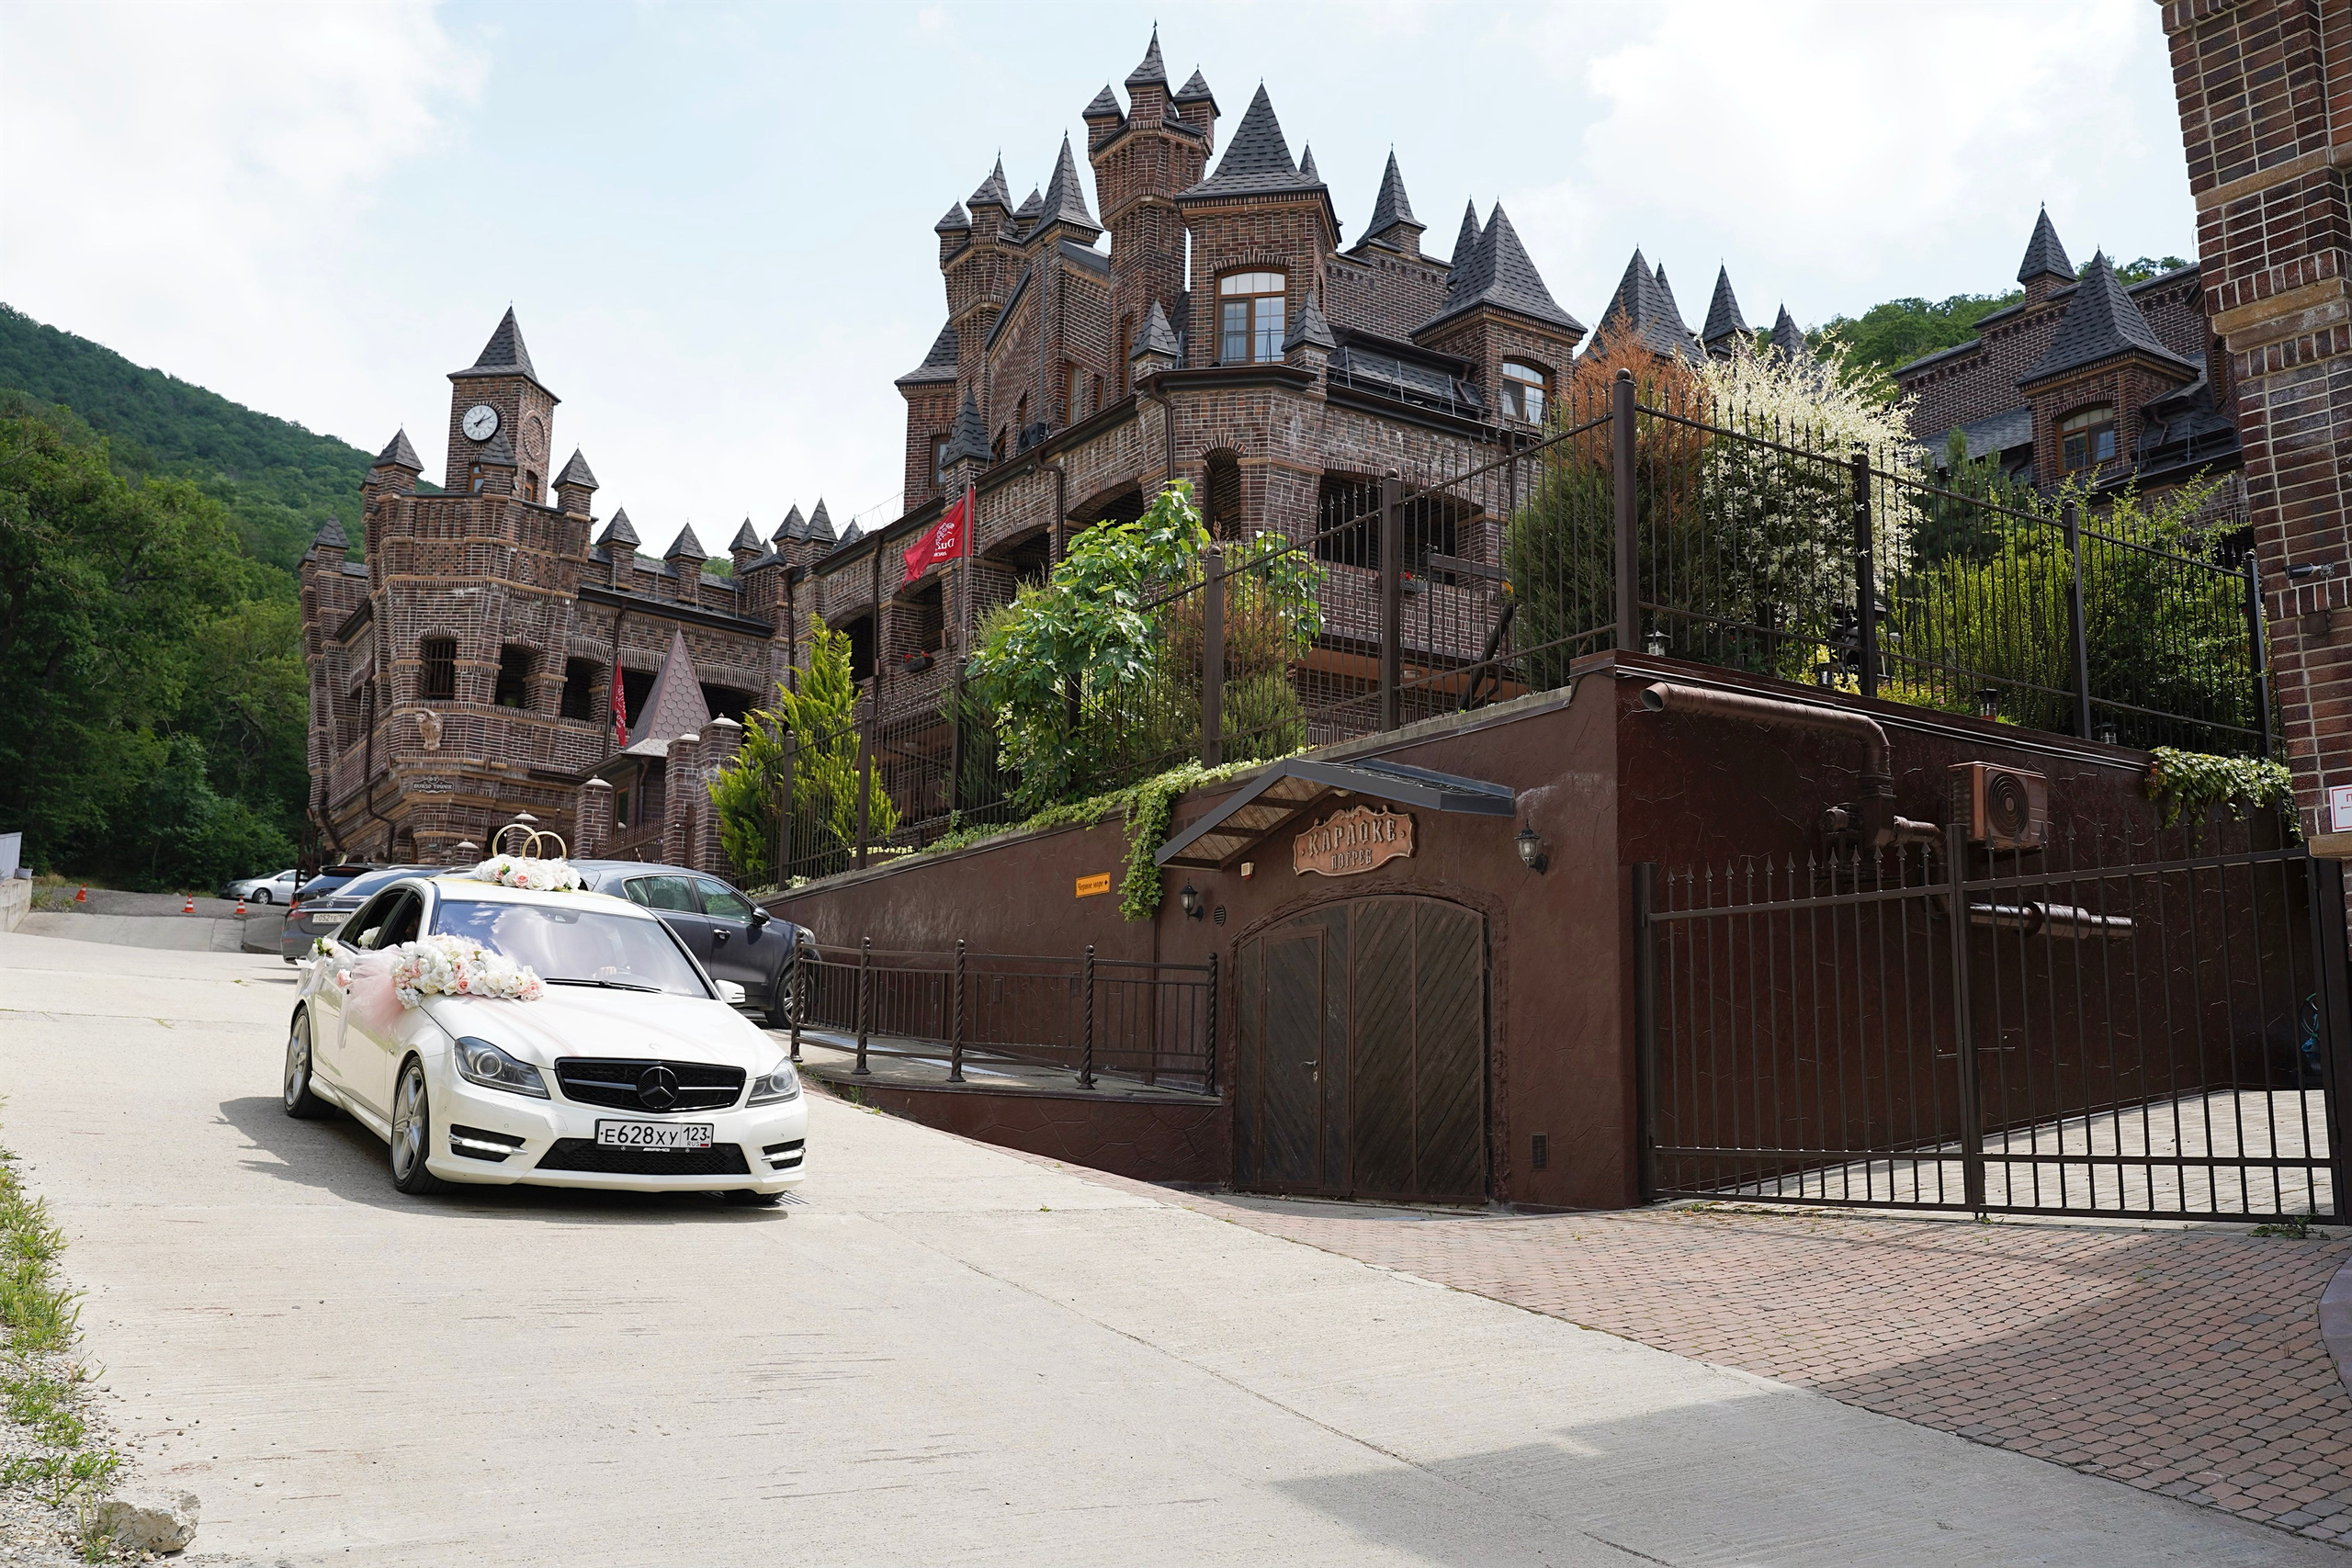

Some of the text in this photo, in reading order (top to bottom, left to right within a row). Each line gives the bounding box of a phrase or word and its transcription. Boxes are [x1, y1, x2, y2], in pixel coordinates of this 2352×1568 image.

[1308, 818, 1396, 857] КАРАОКЕ
[1331, 850, 1372, 870] ПОГРЕБ
[684, 1127, 707, 1141] 123
